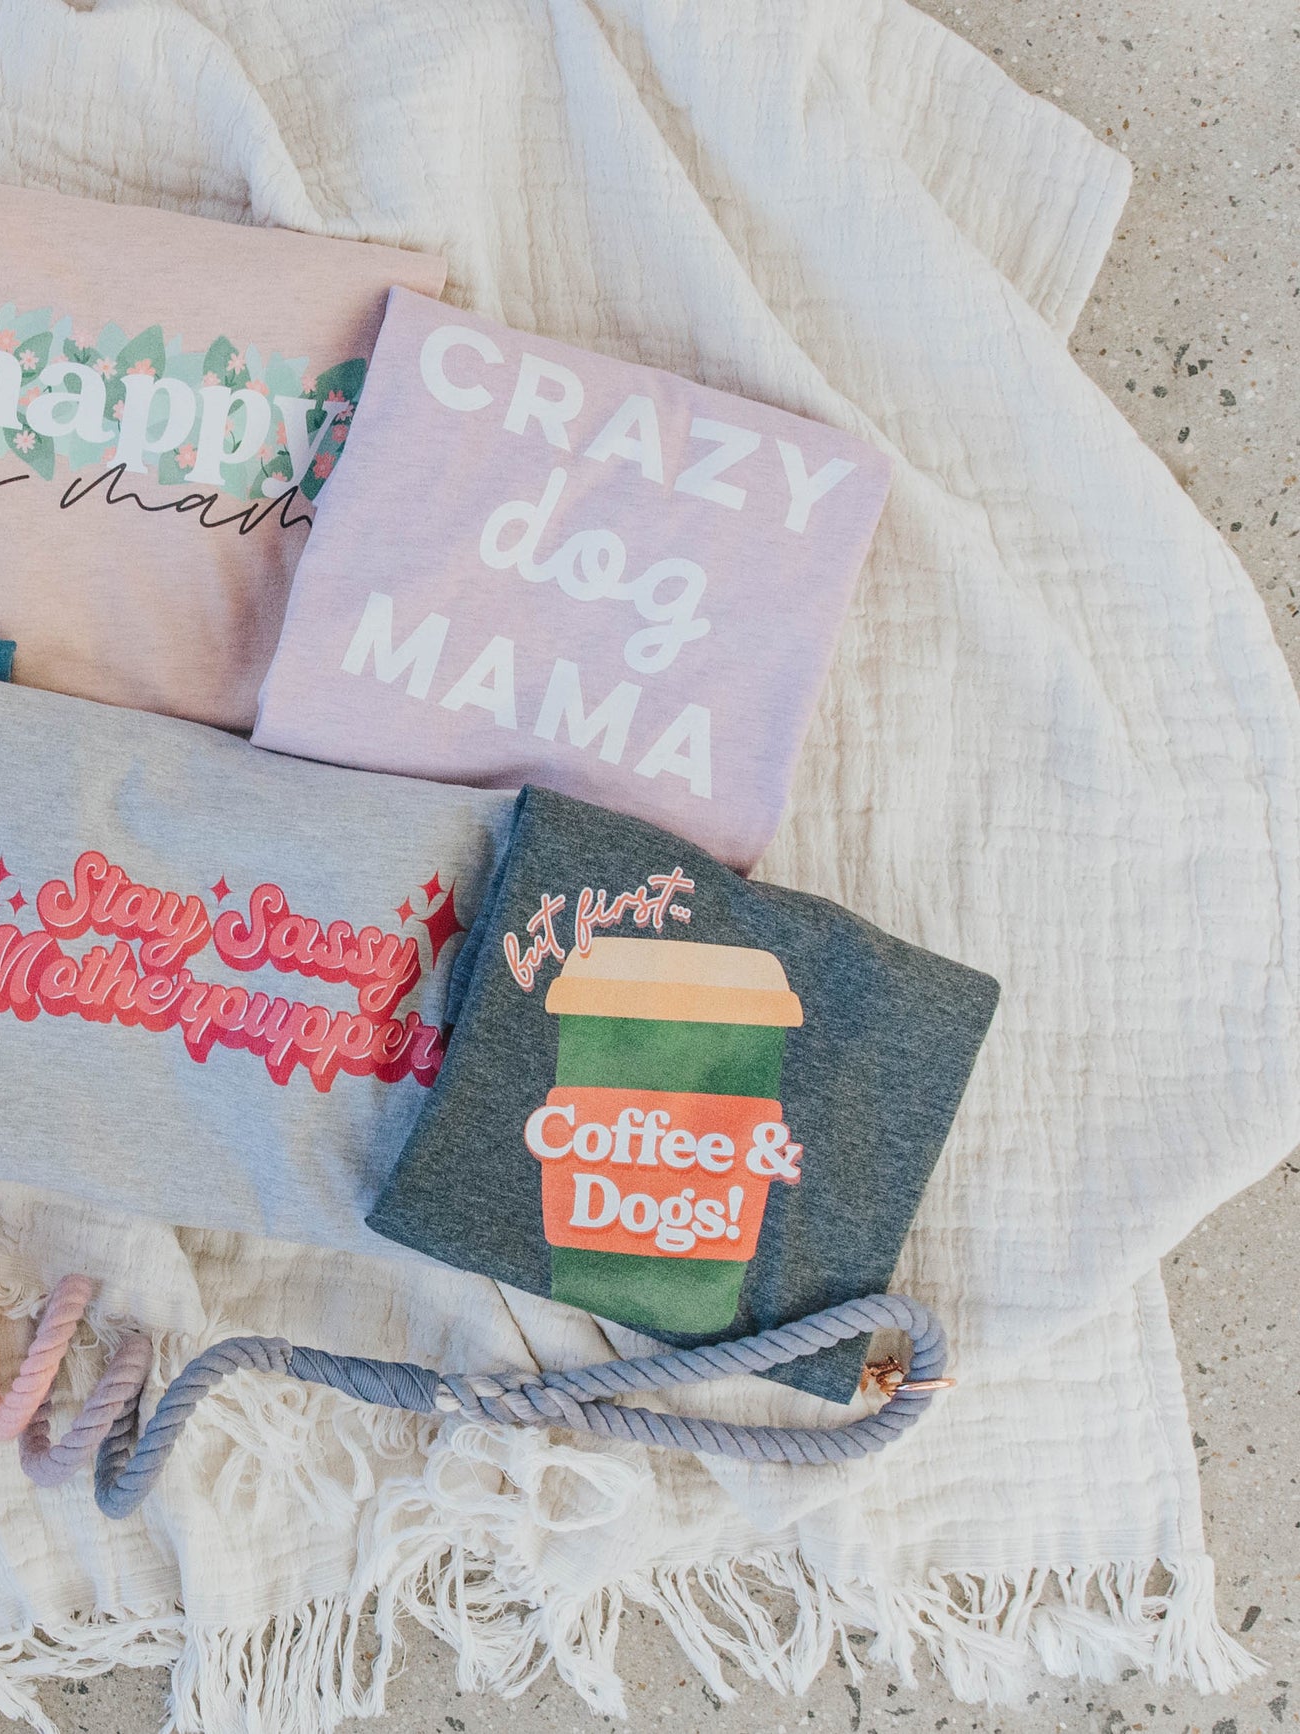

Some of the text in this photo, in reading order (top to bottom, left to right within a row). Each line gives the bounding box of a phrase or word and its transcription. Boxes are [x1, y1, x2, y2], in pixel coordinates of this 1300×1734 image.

[419, 324, 858, 534] CRAZY
[479, 467, 711, 674] dog
[340, 591, 713, 799] MAMA
[36, 850, 422, 1018] Stay Sassy
[504, 894, 565, 990] but
[525, 1104, 803, 1179] Coffee &
[569, 1173, 744, 1252] Dogs!
